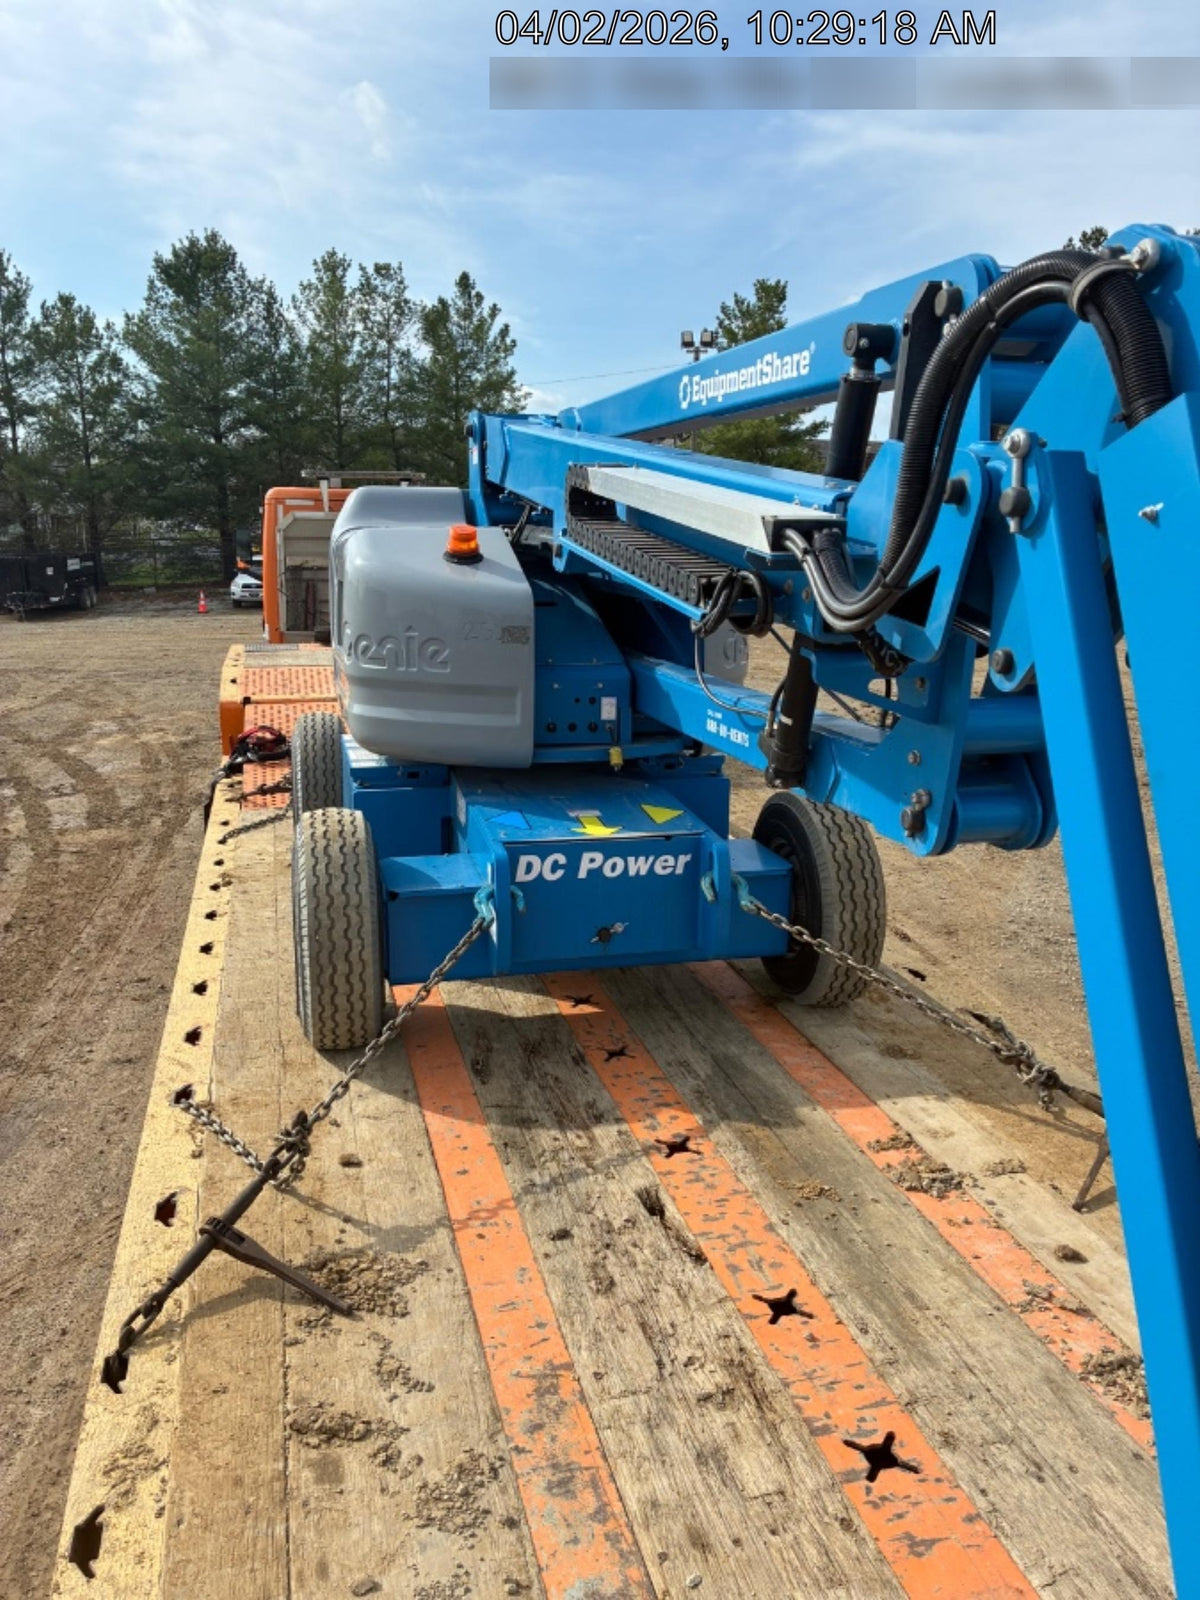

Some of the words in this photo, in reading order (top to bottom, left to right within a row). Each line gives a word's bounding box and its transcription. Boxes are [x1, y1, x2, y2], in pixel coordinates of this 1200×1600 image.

[692, 351, 810, 406] EquipmentShare
[515, 853, 567, 883] DC
[577, 851, 692, 879] Power
